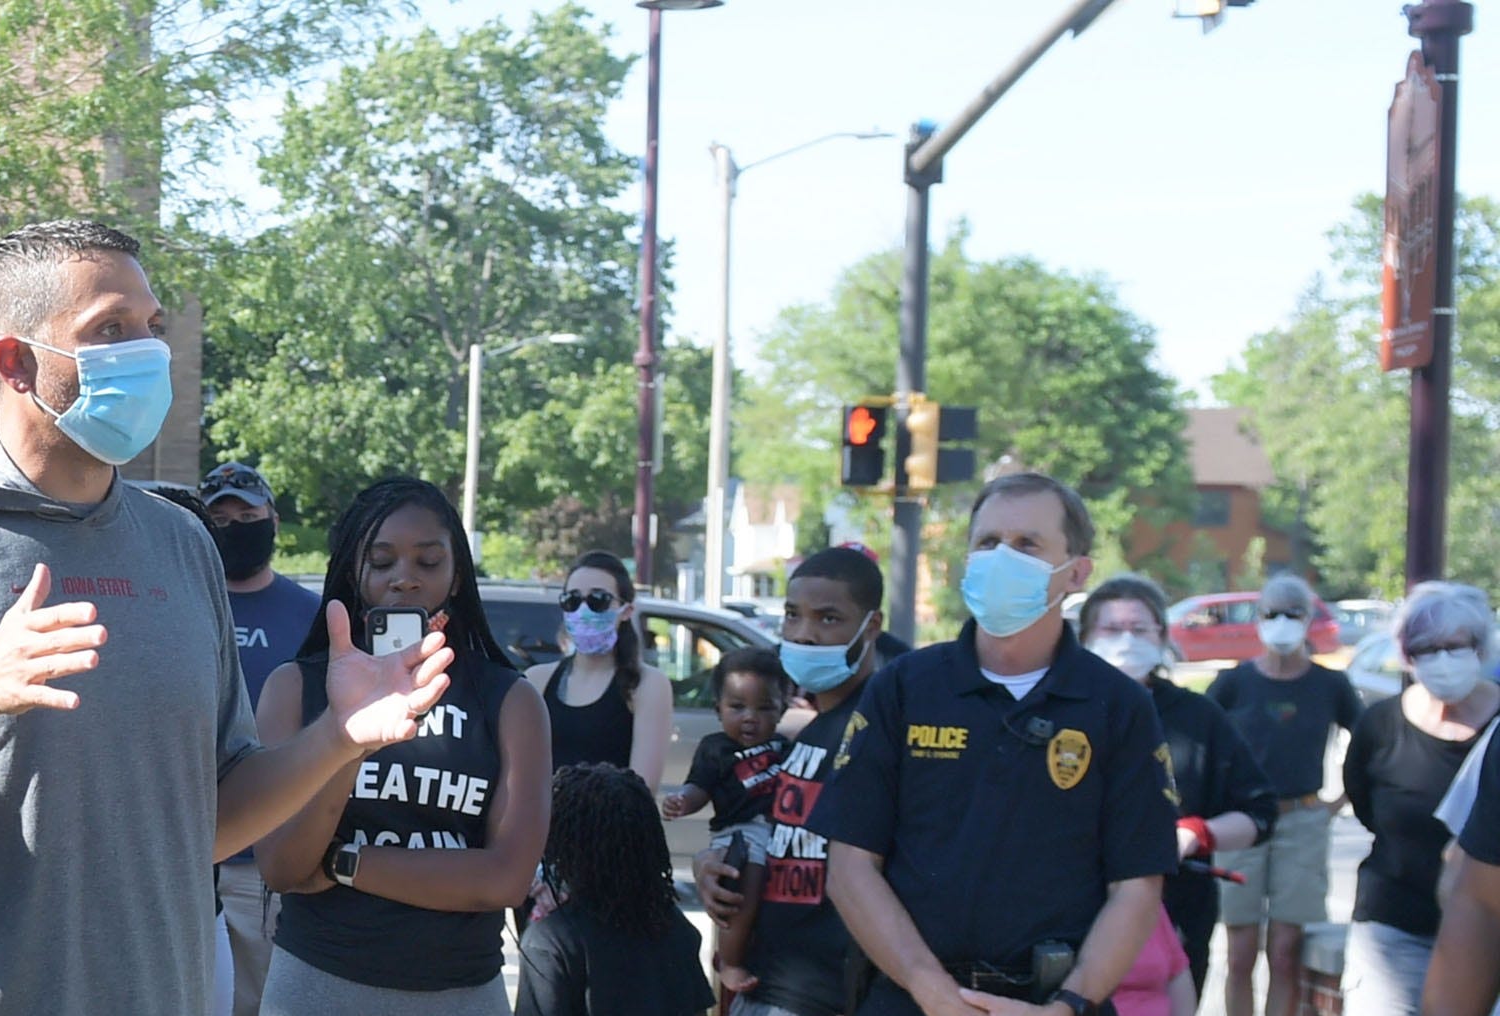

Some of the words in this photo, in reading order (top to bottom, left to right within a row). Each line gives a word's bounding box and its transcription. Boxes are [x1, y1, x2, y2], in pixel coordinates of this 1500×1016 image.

[61, 575, 97, 596] IOWA
[234, 626, 269, 648] SA
[418, 704, 468, 739] NT
[906, 724, 969, 749] POLICE
[350, 761, 489, 816] EATHE
